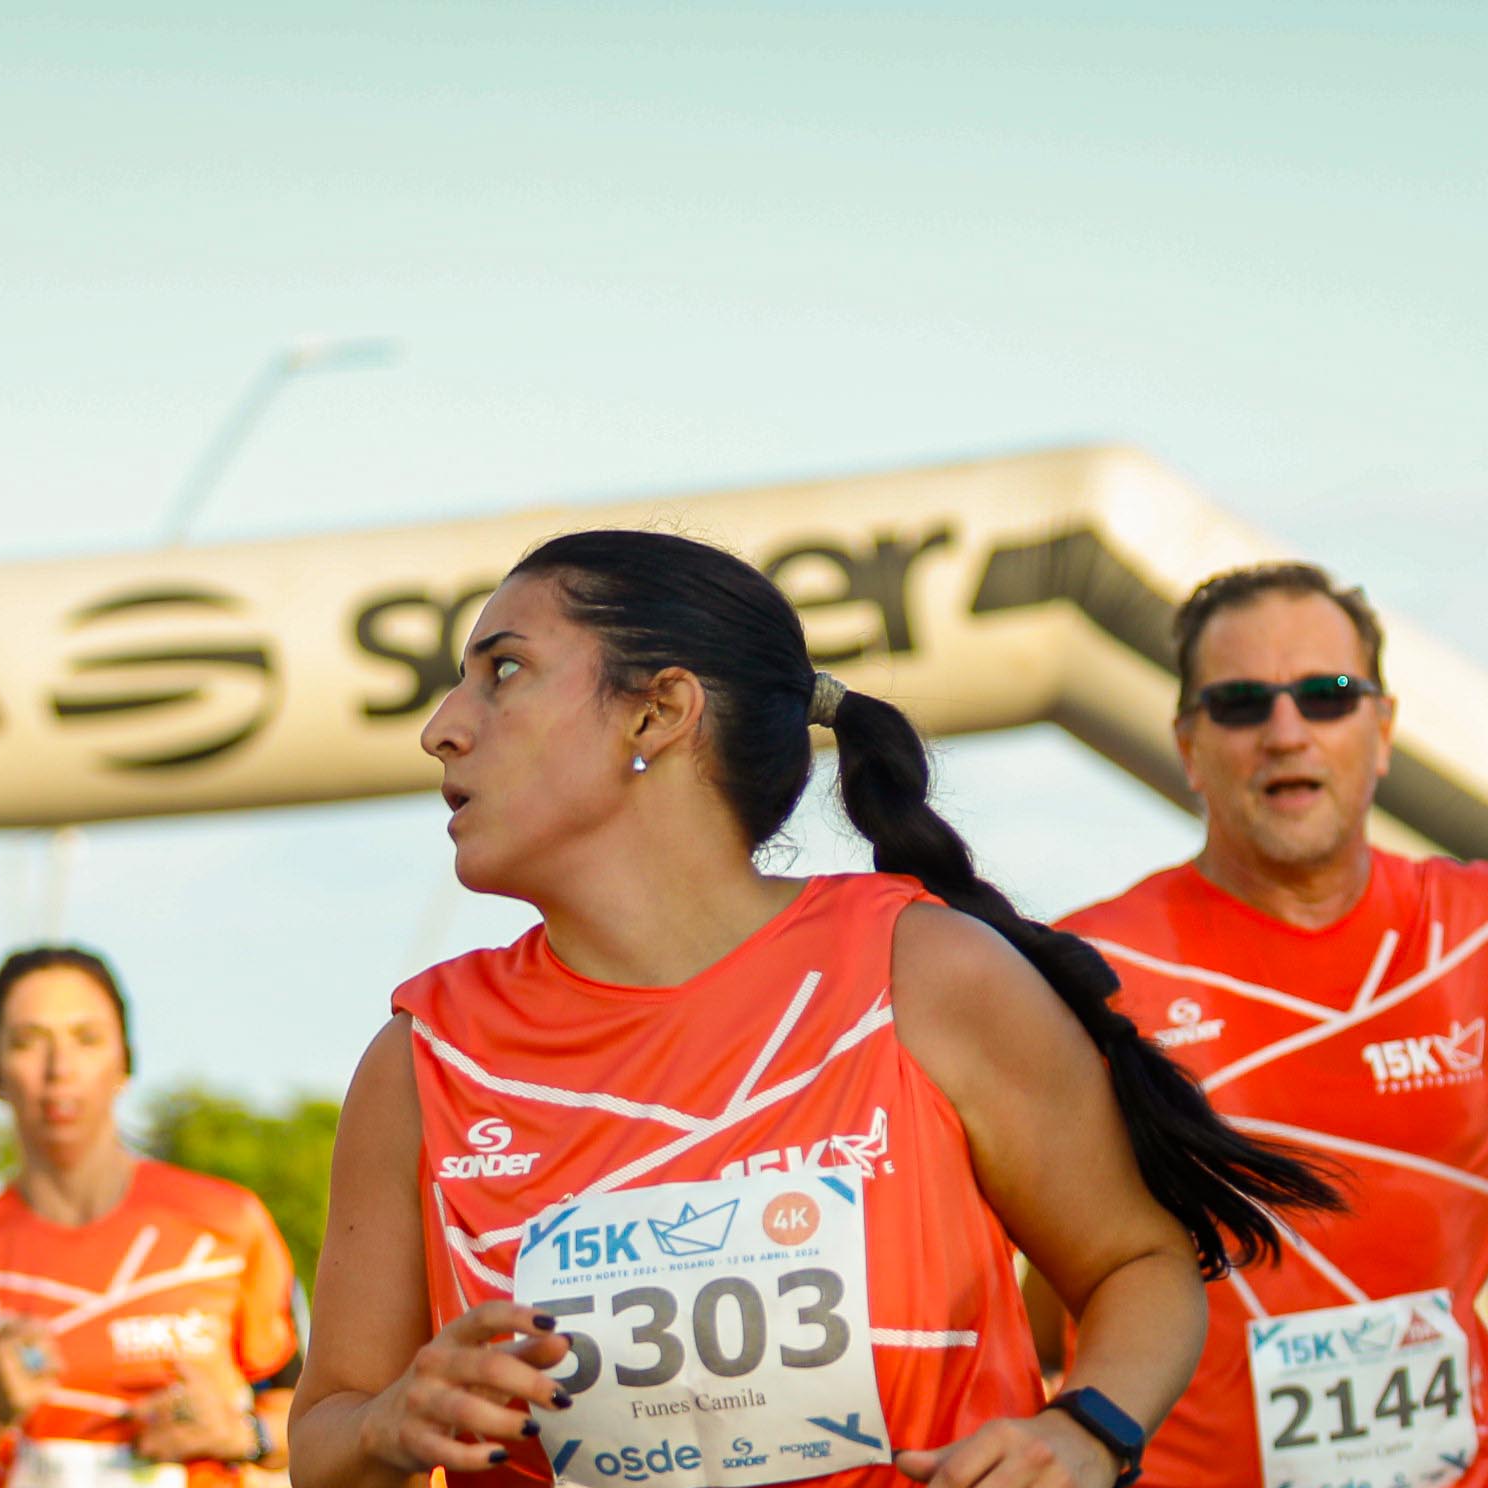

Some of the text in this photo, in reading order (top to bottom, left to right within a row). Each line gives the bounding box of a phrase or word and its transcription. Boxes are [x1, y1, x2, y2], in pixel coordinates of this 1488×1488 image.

[1361, 1034, 1442, 1081] 15K
[773, 1205, 810, 1230] 4K
[552, 1220, 641, 1271] 15K
[552, 1274, 592, 1286] PUERTO
[595, 1269, 630, 1281] NORTE
[532, 1267, 851, 1396] 5303
[1276, 1331, 1337, 1366] 15K
[631, 1388, 767, 1419] Funes Camila
[1269, 1354, 1463, 1449] 2144
[594, 1439, 702, 1479] osde
